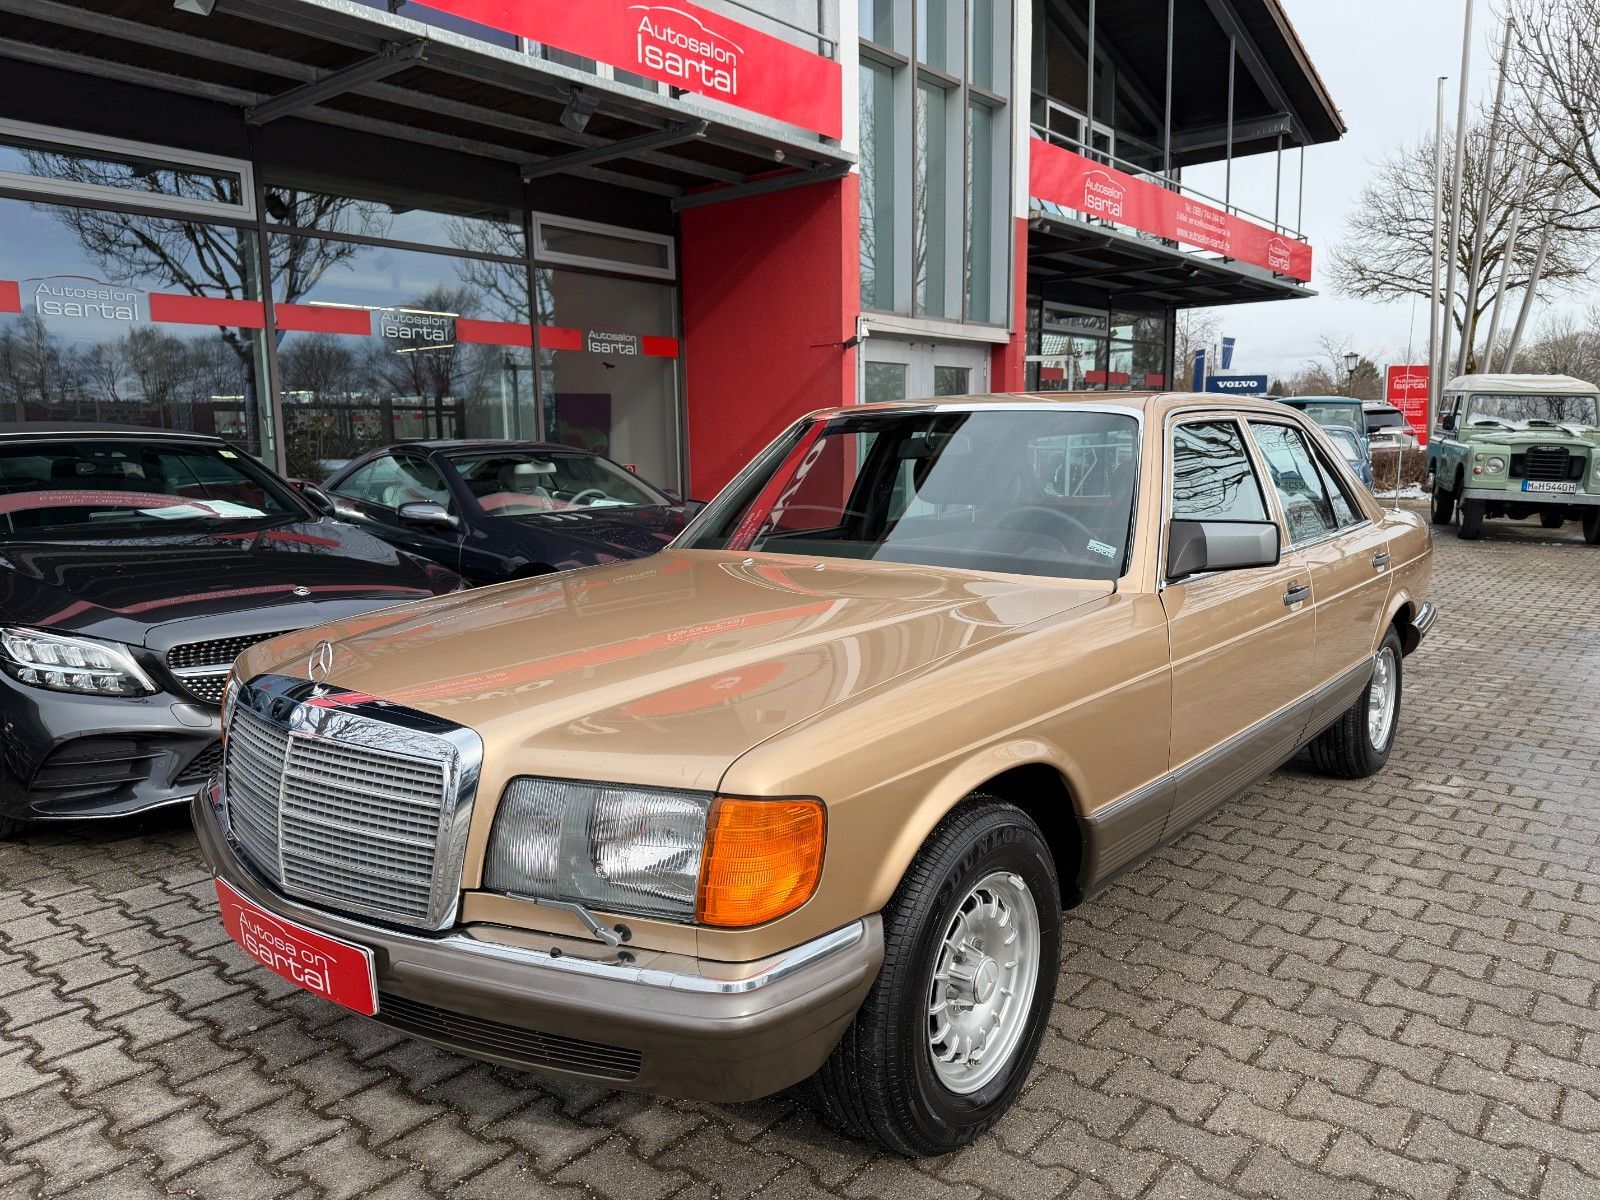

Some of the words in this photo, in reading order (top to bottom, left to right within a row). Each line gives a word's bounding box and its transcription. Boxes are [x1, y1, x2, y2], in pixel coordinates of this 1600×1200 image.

[637, 15, 737, 64] Autosalon
[637, 33, 737, 96] Isartal
[1085, 178, 1124, 199] Autosalon
[1084, 188, 1123, 217] Isartal
[35, 282, 137, 302] Autosalon
[35, 295, 139, 321] Isartal
[381, 312, 448, 326] Autosalon
[381, 324, 448, 341] Isartal
[588, 330, 637, 342] Autosalon
[588, 339, 637, 355] Isartal
[1217, 380, 1258, 388] VOLVO
[239, 923, 331, 994] Isartal
